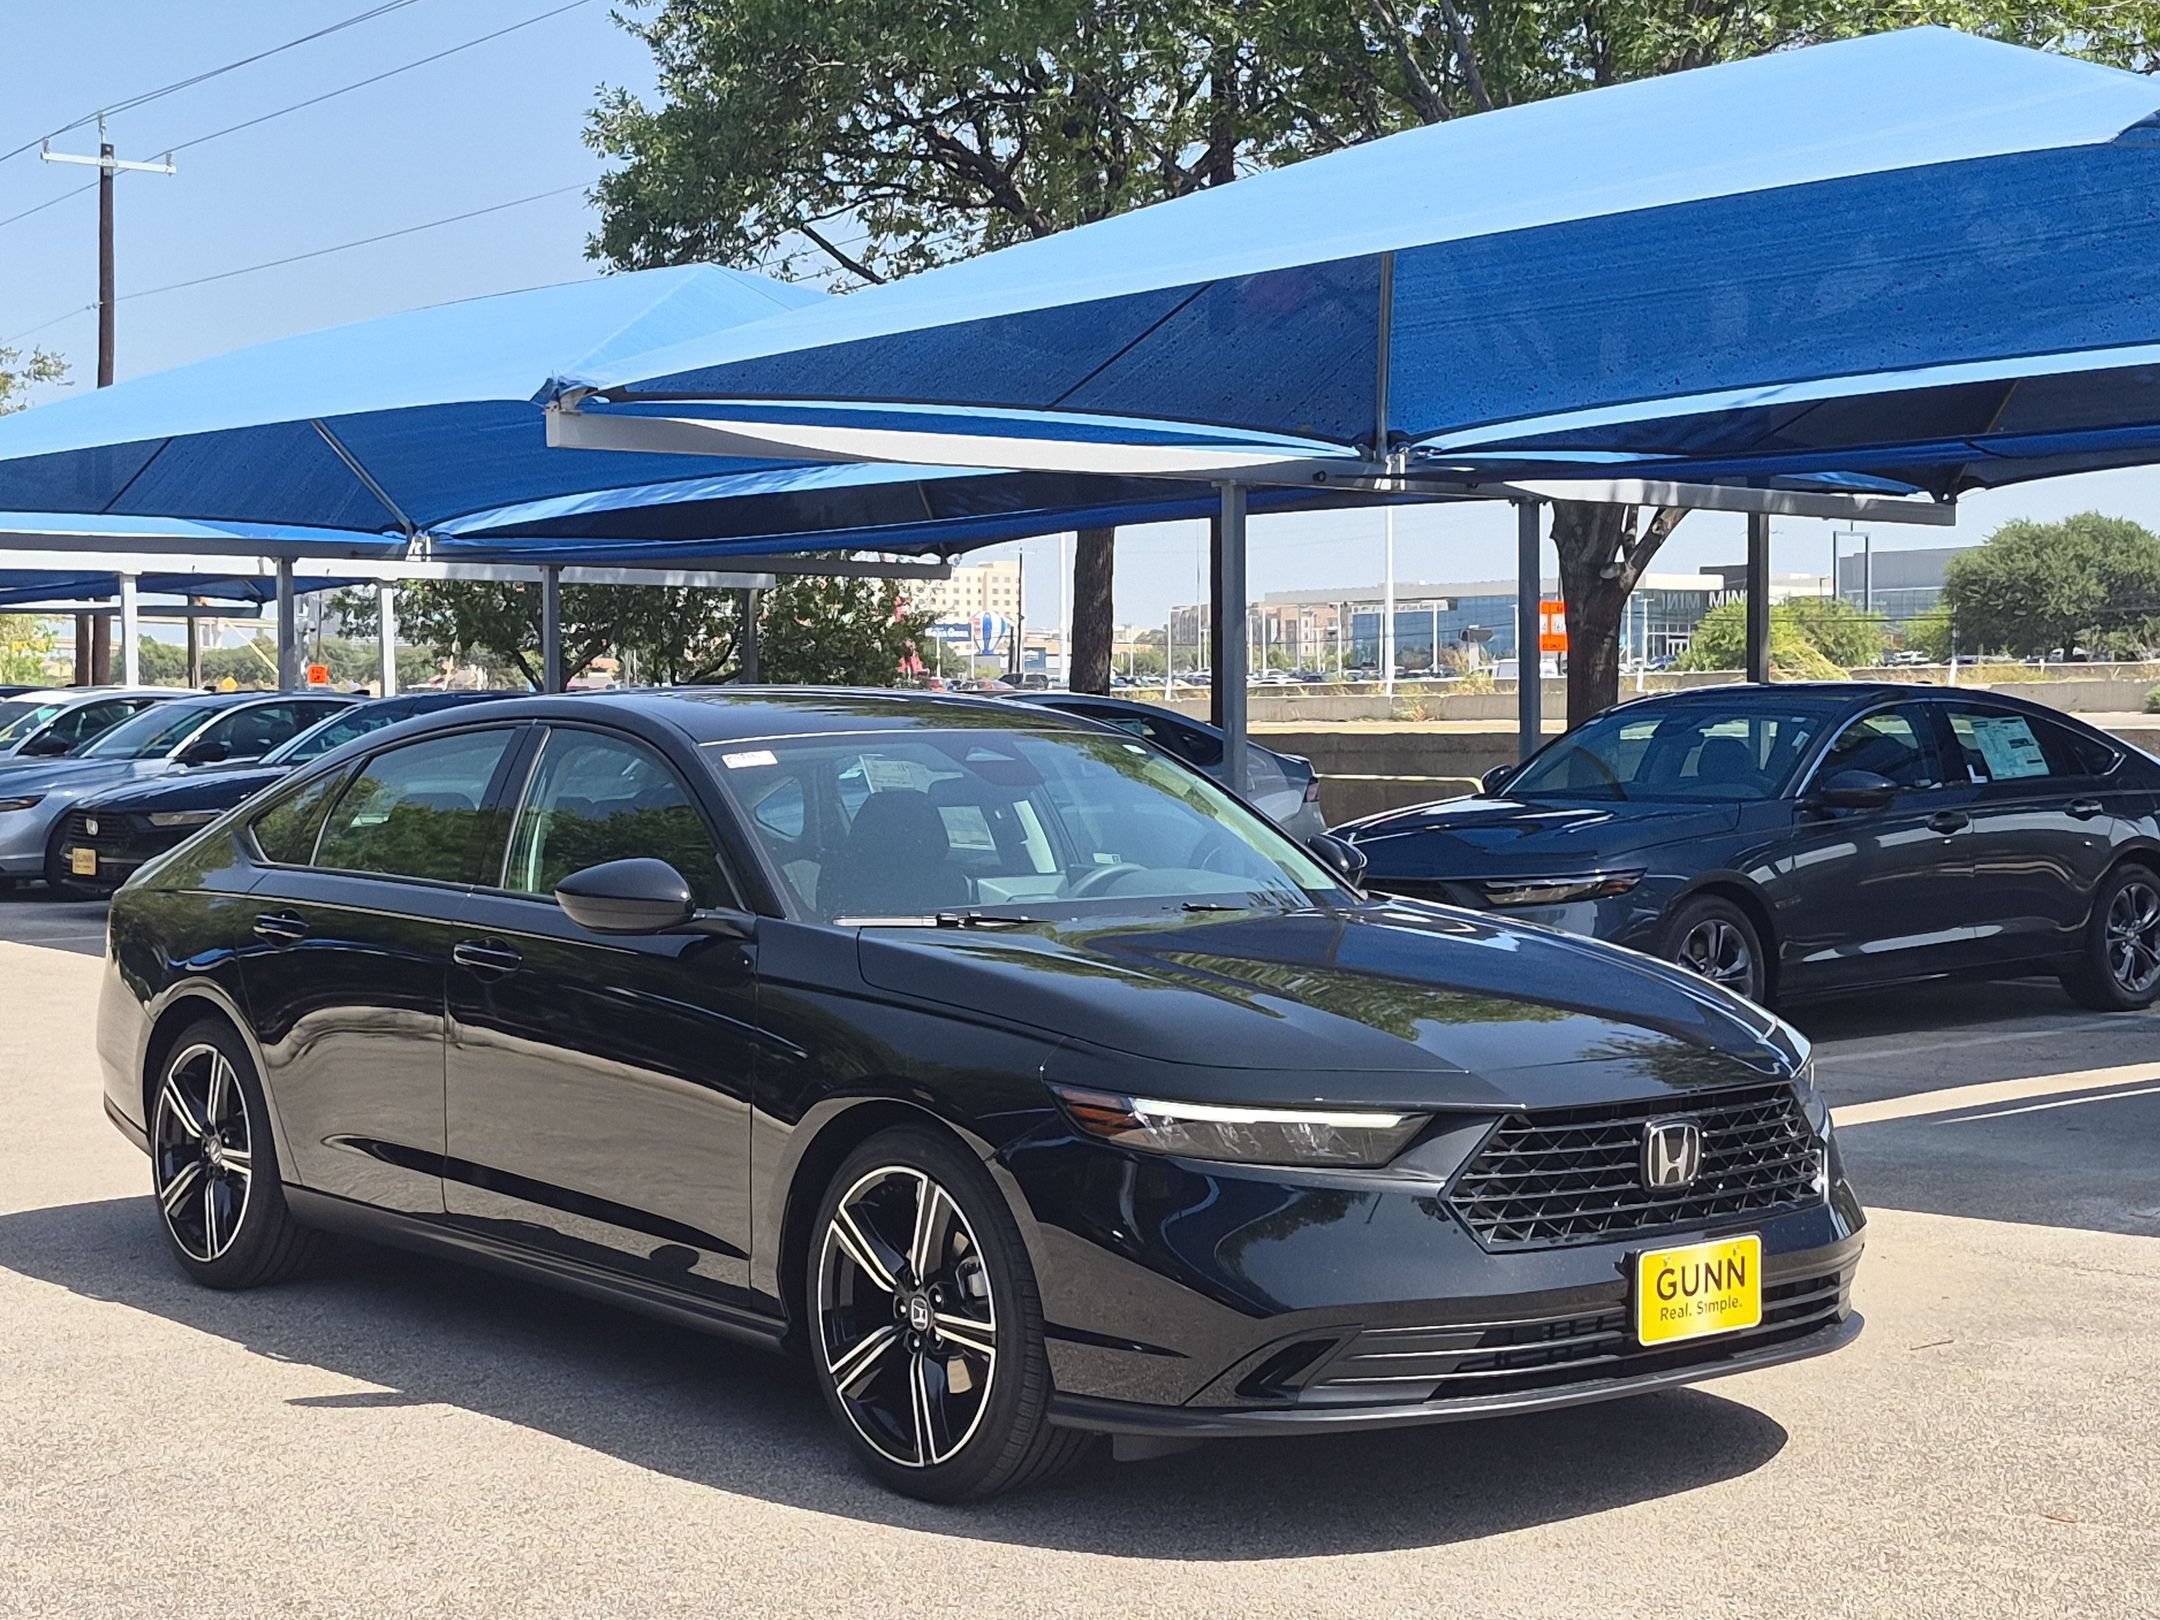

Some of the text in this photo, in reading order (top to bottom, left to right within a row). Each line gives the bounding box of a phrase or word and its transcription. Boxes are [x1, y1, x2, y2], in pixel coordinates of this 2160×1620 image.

[1656, 1256, 1745, 1300] GUNN
[1660, 1296, 1743, 1321] Real. Simple.
